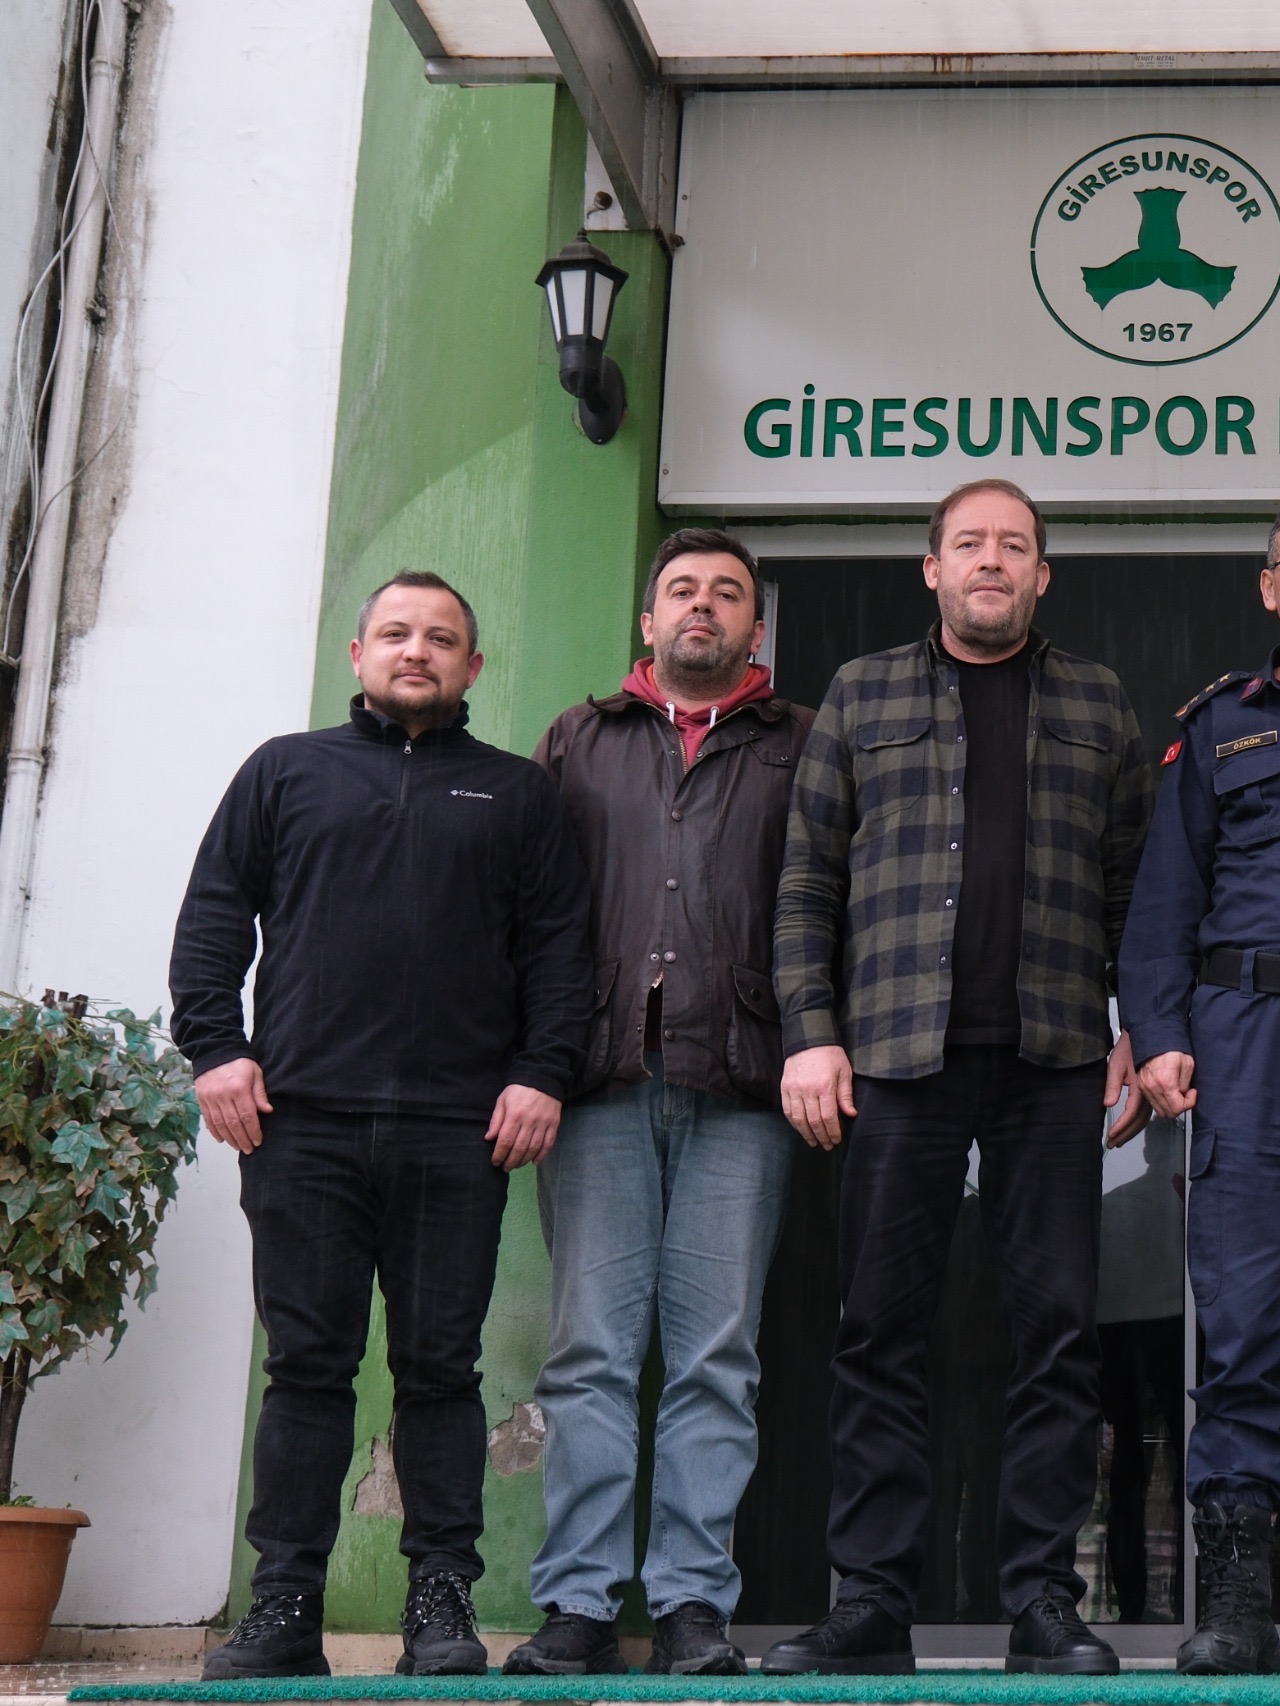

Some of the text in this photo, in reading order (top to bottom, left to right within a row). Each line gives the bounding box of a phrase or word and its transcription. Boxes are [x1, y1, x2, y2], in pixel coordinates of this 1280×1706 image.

[1057, 151, 1262, 224] GİRESUNSPOR
[1122, 322, 1193, 343] 1967
[743, 384, 1257, 458] GİRESUNSPOR
[459, 789, 493, 800] Columbia
